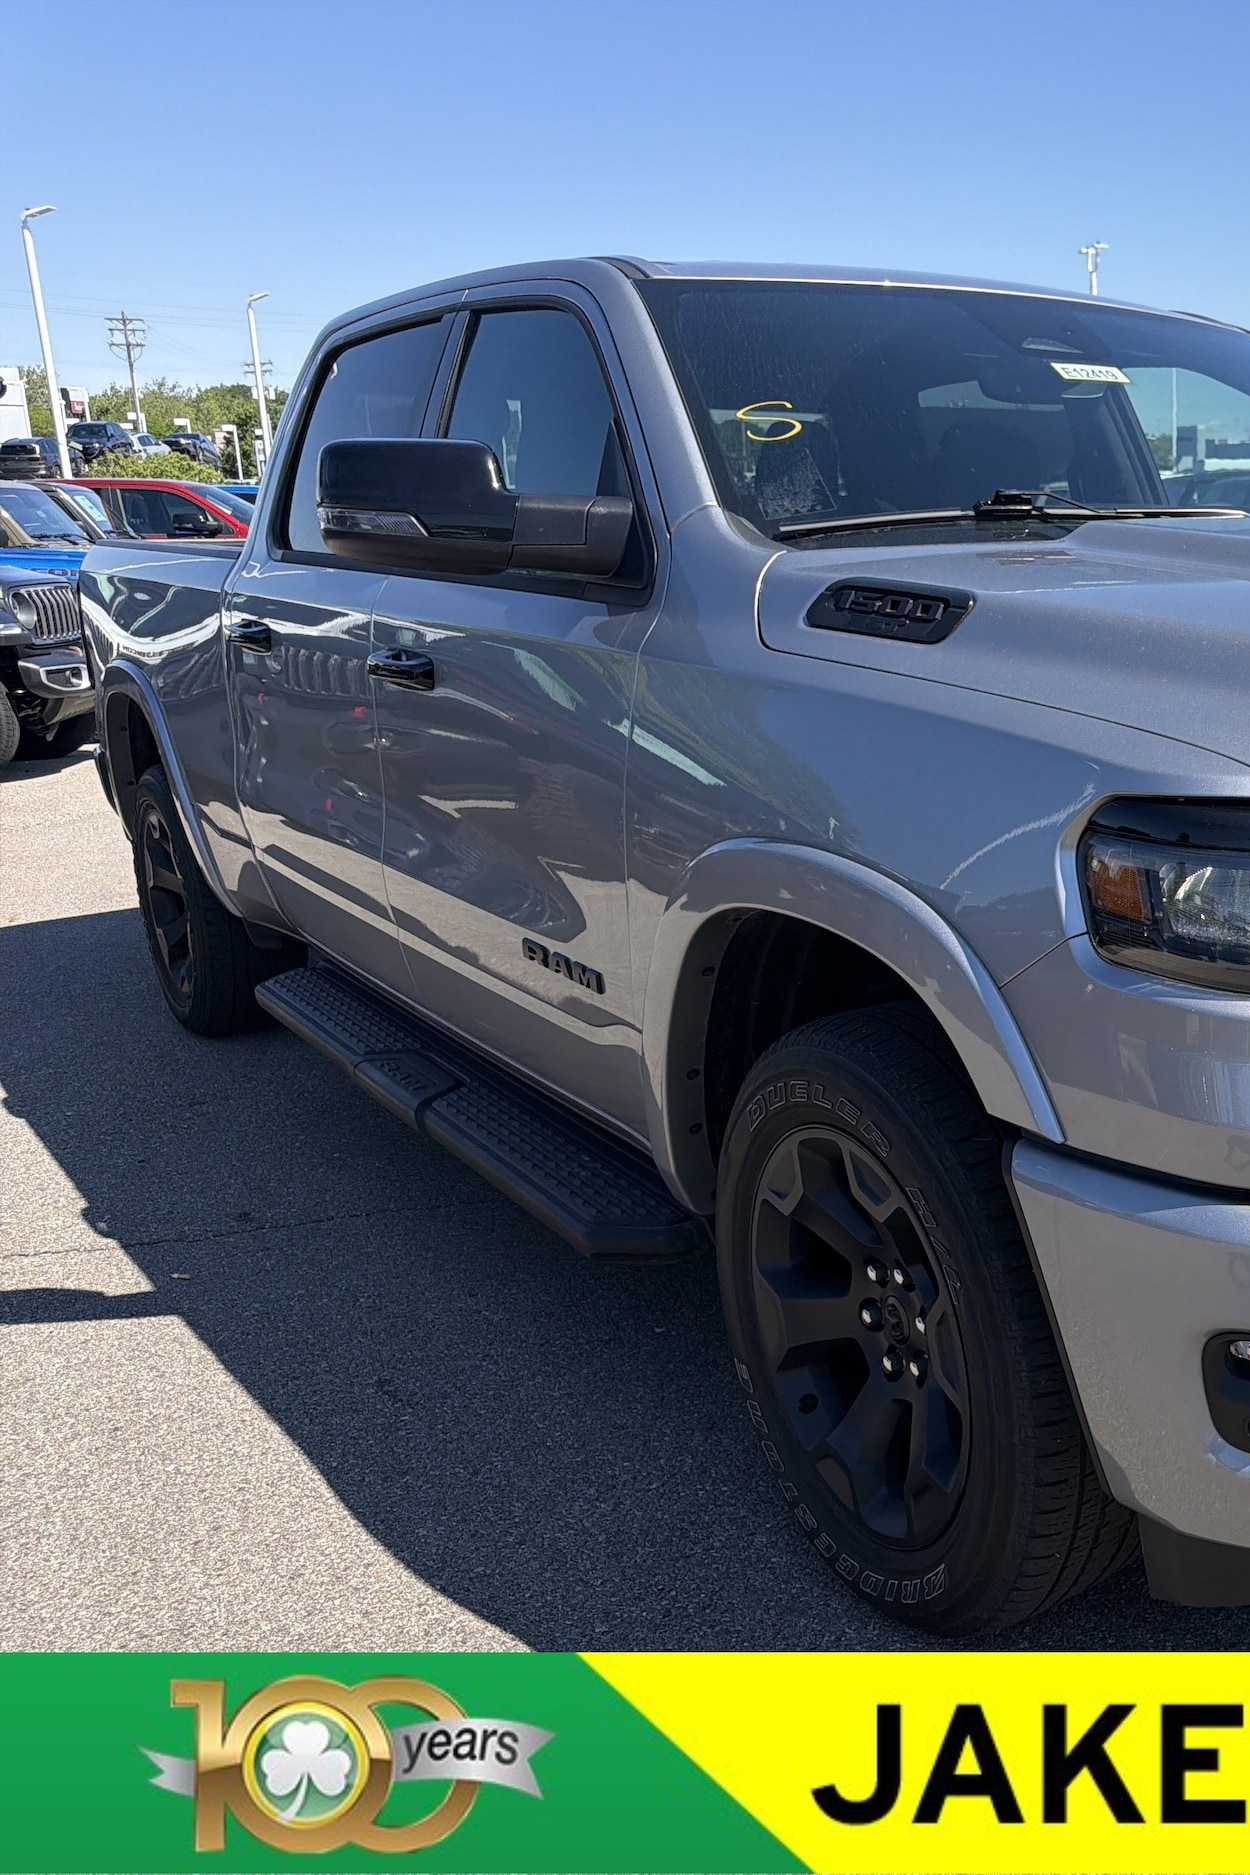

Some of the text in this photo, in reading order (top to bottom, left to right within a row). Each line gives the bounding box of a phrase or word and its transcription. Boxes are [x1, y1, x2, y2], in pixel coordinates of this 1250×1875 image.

[1060, 367, 1119, 380] E12419
[736, 400, 803, 441] S
[832, 589, 945, 623] 1500
[522, 937, 606, 995] RAM
[746, 1080, 891, 1157] DUELER
[733, 1357, 946, 1604] BRIDGESTONE
